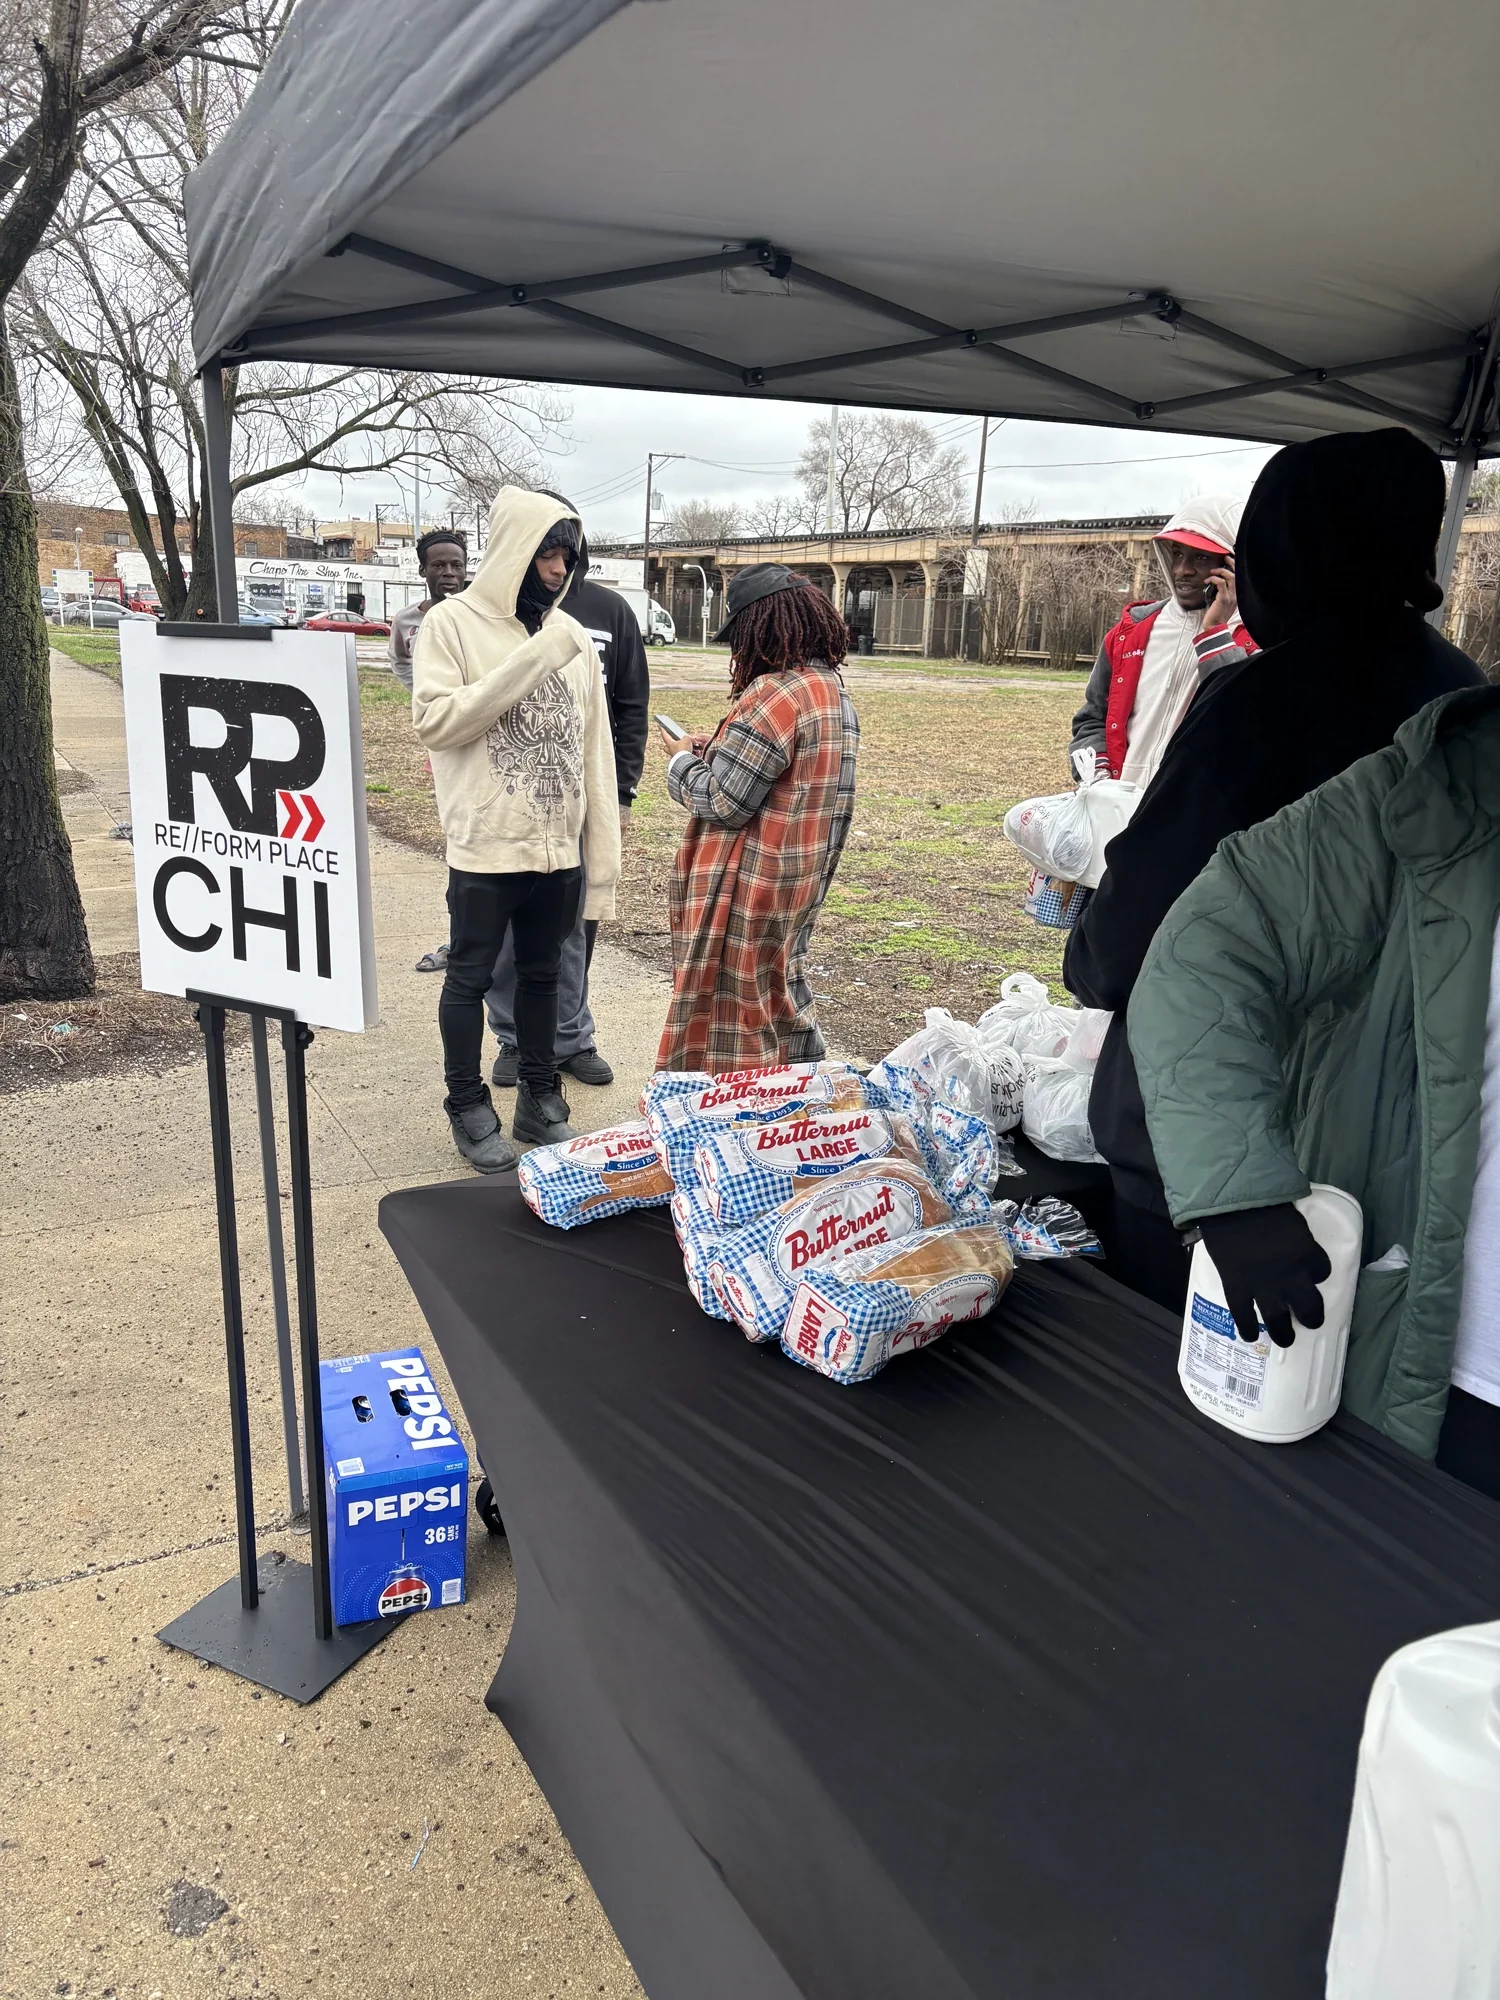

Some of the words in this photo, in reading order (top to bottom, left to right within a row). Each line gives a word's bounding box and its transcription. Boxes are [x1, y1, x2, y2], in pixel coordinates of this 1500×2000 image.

[315, 564, 341, 580] Shop
[159, 673, 326, 837] RP
[155, 823, 262, 863] RE//FORM
[270, 841, 339, 876] PLACE
[152, 856, 332, 979] CHI
[699, 1076, 812, 1110] Butternut
[604, 1138, 653, 1158] LARG
[757, 1115, 873, 1150] Butternut
[642, 1154, 657, 1165] 189
[796, 1138, 860, 1162] LARGE
[811, 1165, 835, 1175] Since
[784, 1186, 896, 1272] Butternut
[791, 1297, 826, 1360] LARGE
[831, 1328, 852, 1369] Butternut
[380, 1357, 459, 1451] PEPSI
[348, 1483, 461, 1527] PEPSI
[424, 1526, 446, 1545] 36
[447, 1525, 455, 1541] CANS
[381, 1592, 428, 1611] PEPSI
